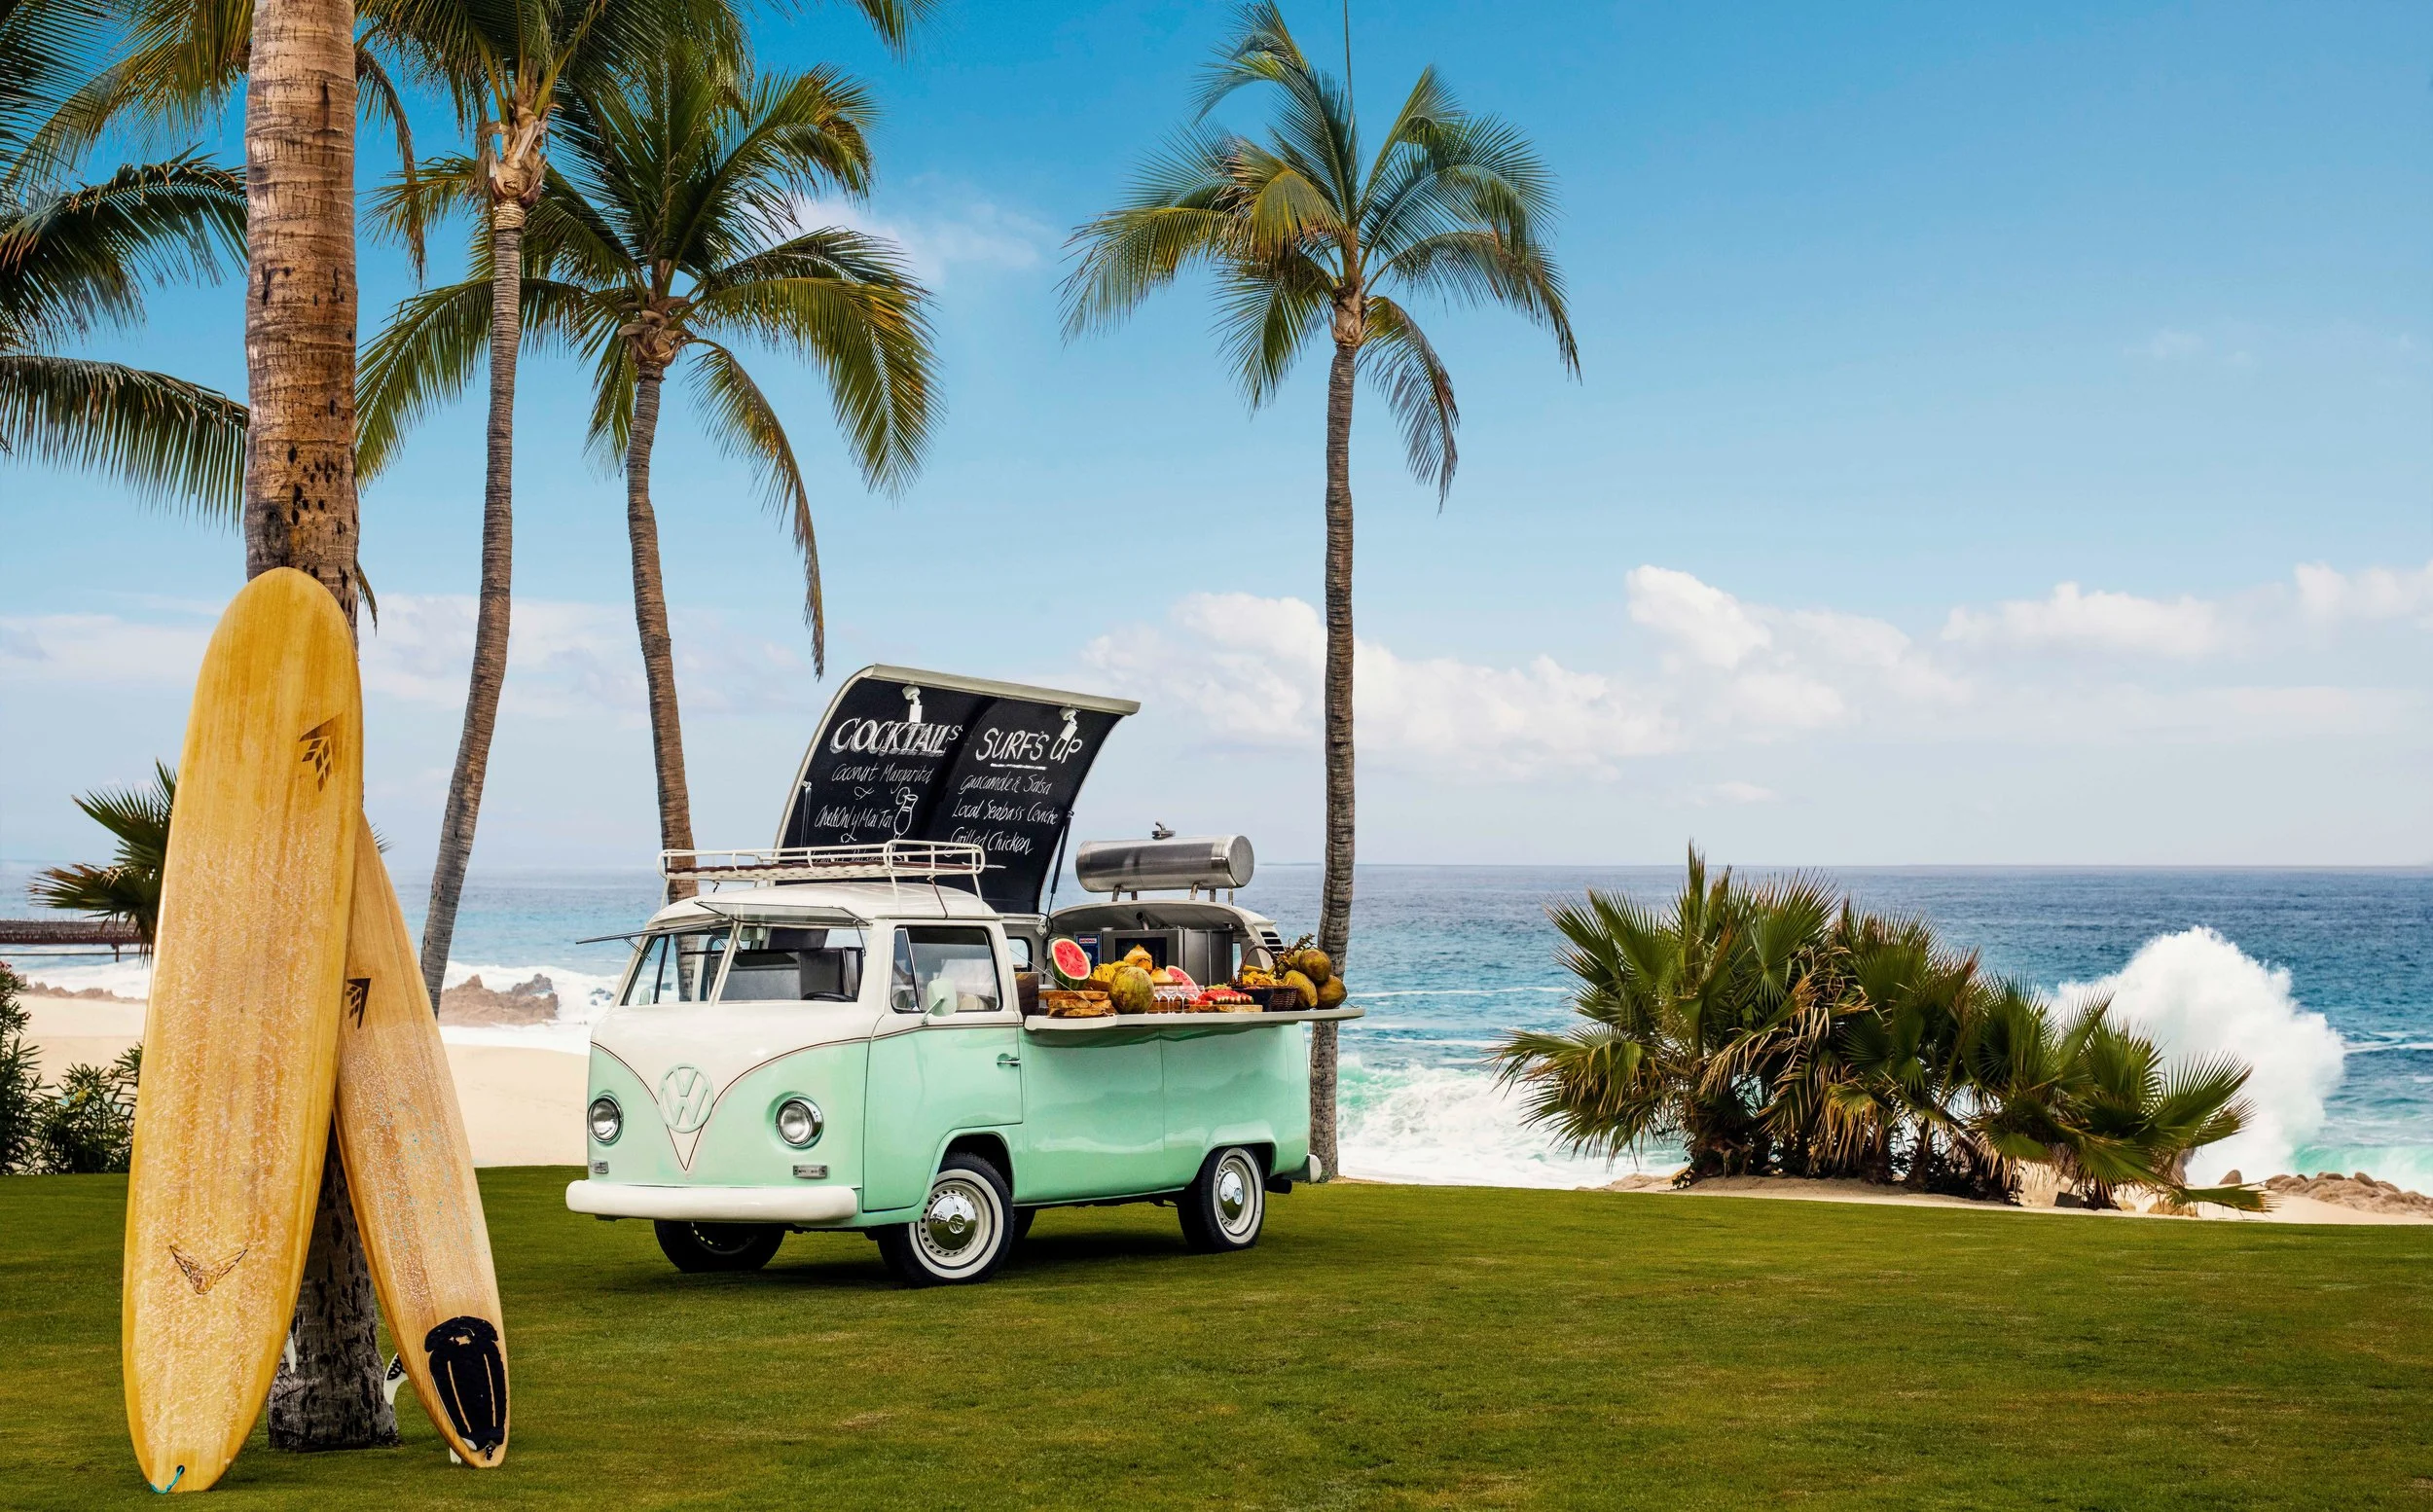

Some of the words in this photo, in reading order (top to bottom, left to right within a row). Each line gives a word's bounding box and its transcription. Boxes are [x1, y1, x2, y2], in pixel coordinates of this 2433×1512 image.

[830, 717, 963, 757] COCKTAILS
[975, 727, 1050, 761] SURF'S
[1050, 736, 1083, 764] UP
[832, 763, 879, 781] Coconut
[880, 763, 935, 794] Margarita
[1024, 774, 1053, 795] Salsa
[952, 798, 985, 818] Local
[983, 800, 1026, 821] Seabass
[944, 826, 991, 857] Grilled
[988, 830, 1034, 855] Chicken
